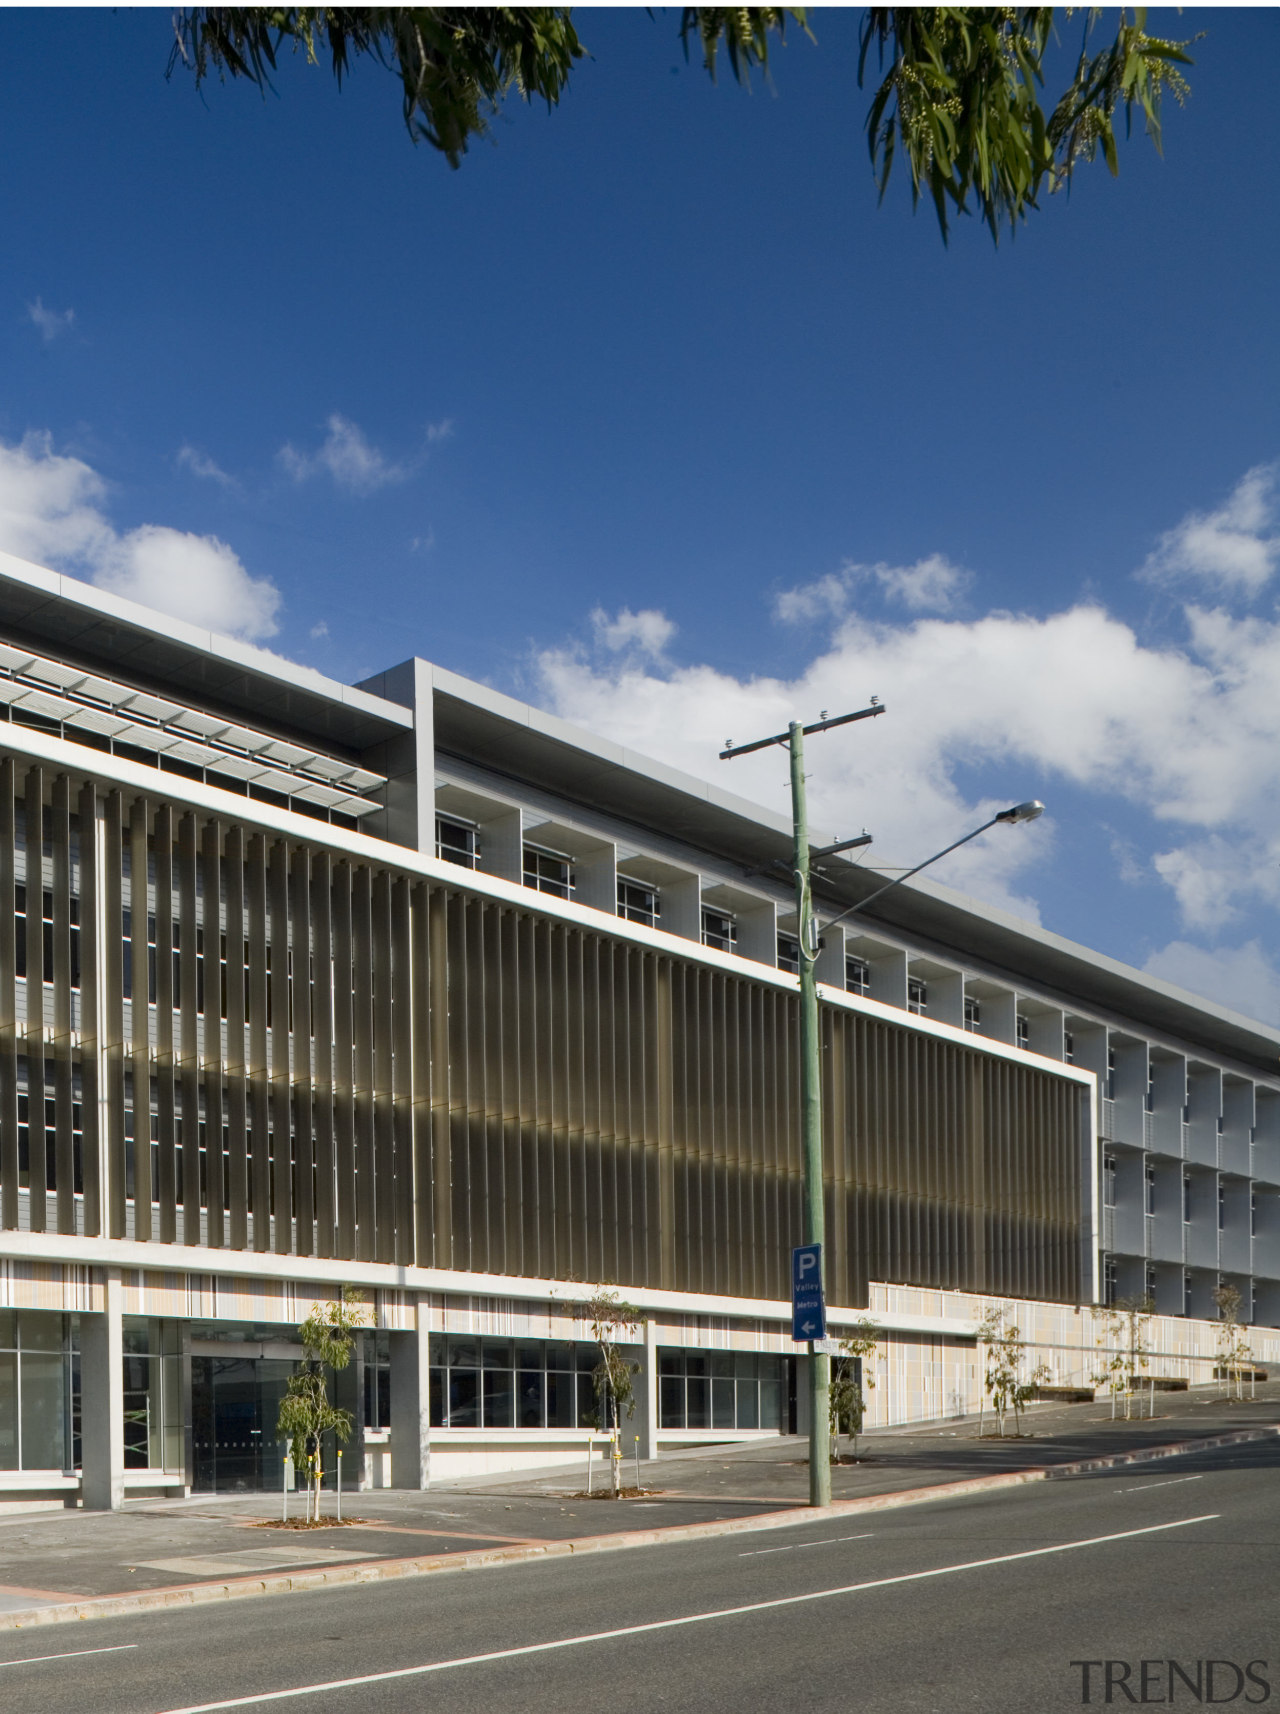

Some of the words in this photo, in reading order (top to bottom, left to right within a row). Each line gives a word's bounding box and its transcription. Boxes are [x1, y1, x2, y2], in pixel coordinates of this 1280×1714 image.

[799, 1253, 816, 1279] P
[795, 1283, 819, 1292] Valley
[797, 1301, 818, 1309] Metro
